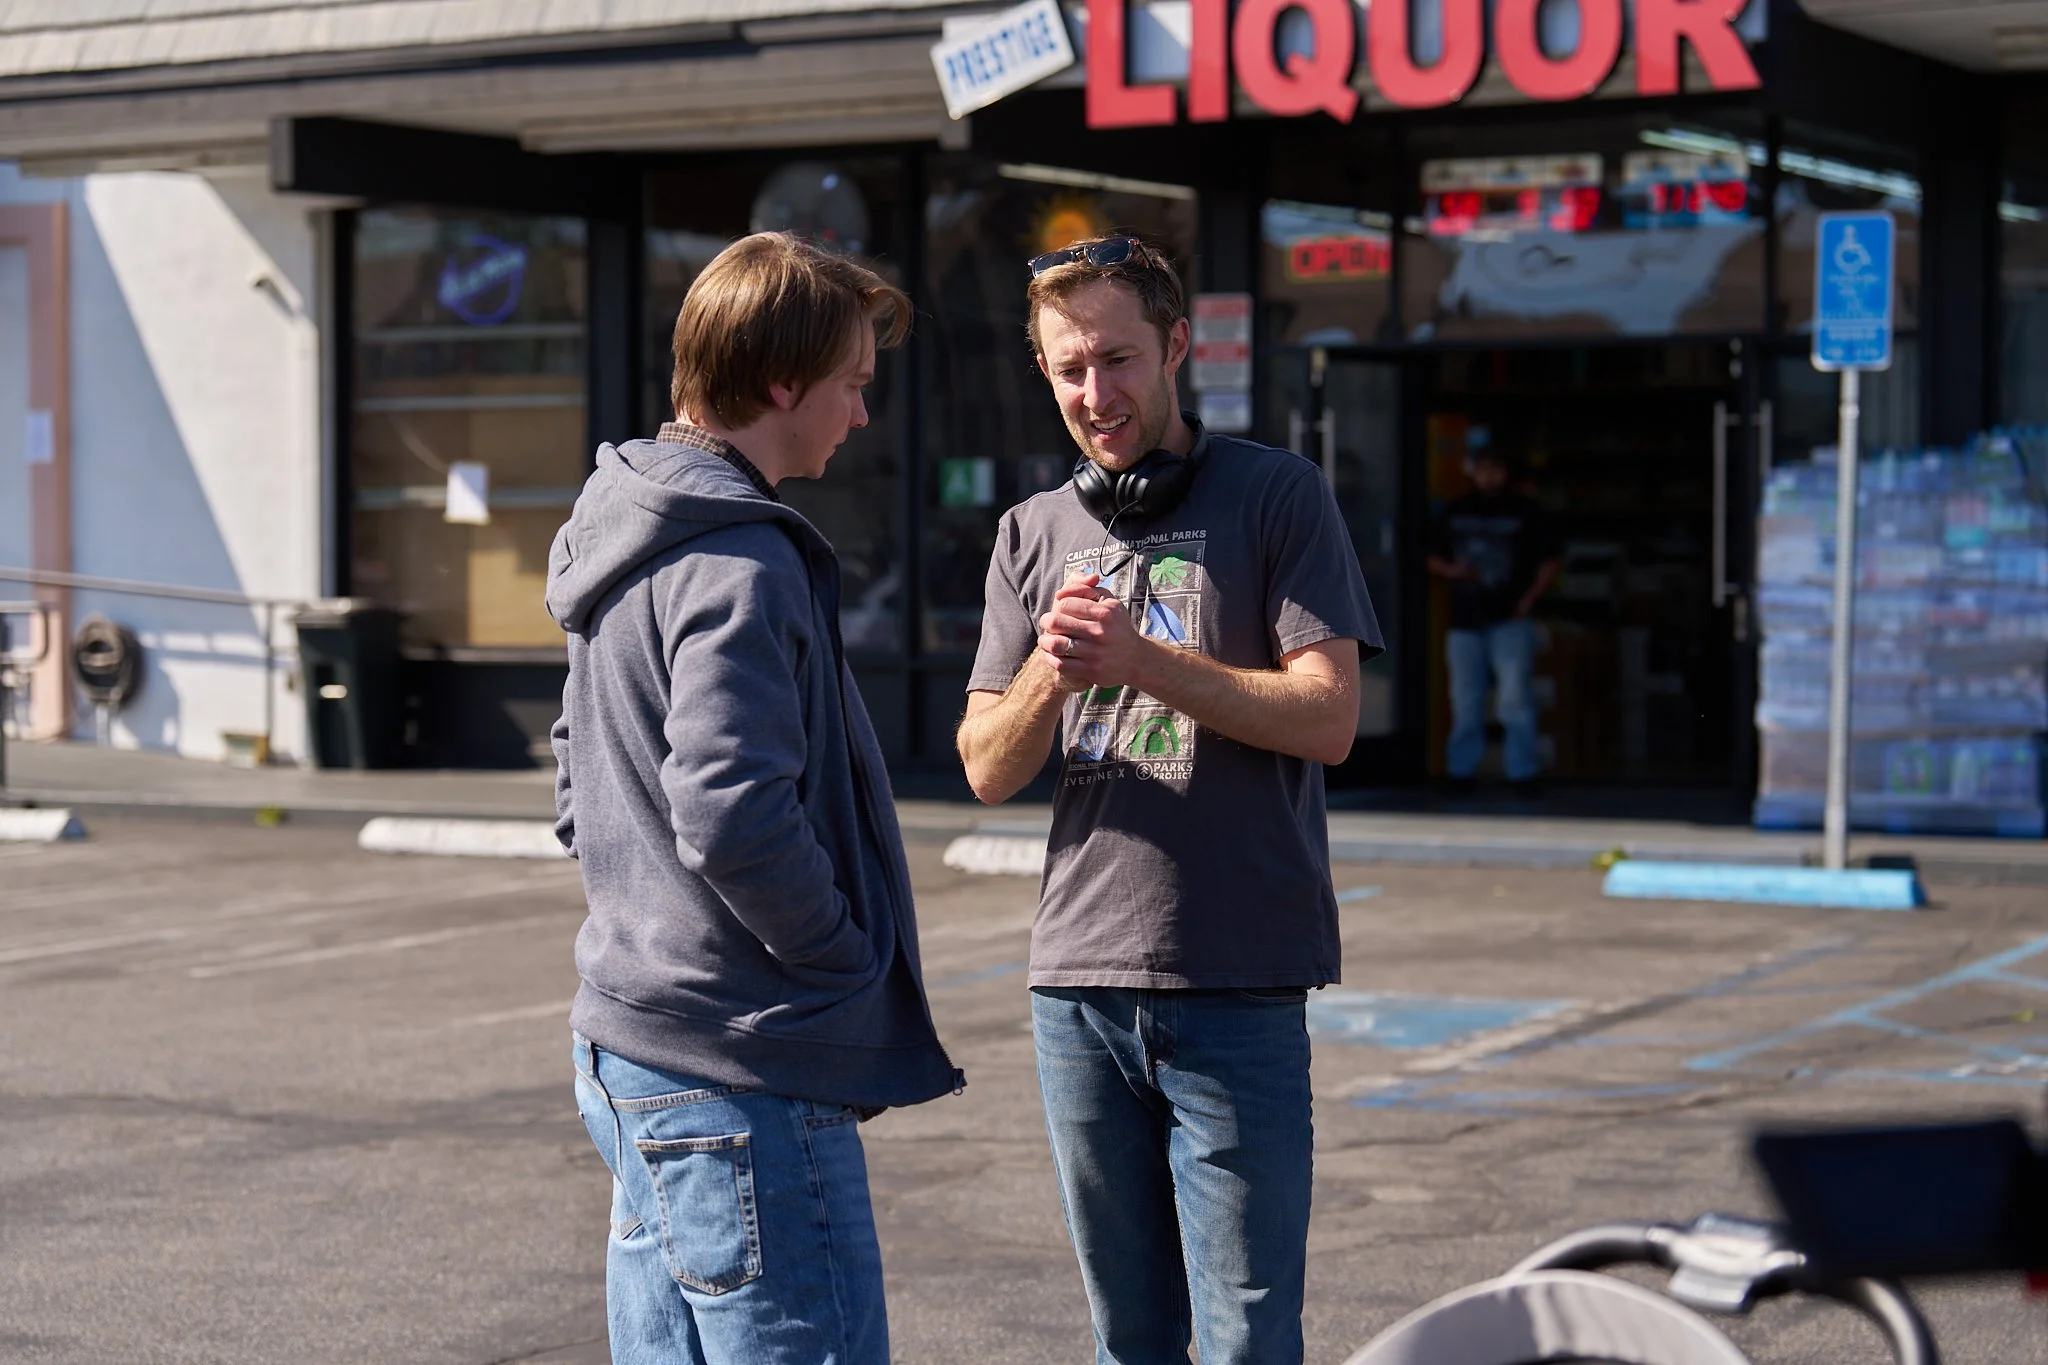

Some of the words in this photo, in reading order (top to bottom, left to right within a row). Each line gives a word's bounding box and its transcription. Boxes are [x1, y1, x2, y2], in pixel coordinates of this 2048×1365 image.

[945, 11, 1056, 93] PRESTIGE
[1085, 0, 1762, 128] LIQUOR
[1291, 236, 1391, 277] OPEN
[1066, 543, 1120, 562] CALIFORNIA
[1121, 534, 1170, 549] NATIONAL
[1172, 530, 1207, 541] PARKS
[1064, 770, 1113, 787] EVERNE
[1117, 767, 1126, 778] X
[1153, 762, 1194, 772] PARKS
[1153, 771, 1193, 780] PROJECT
